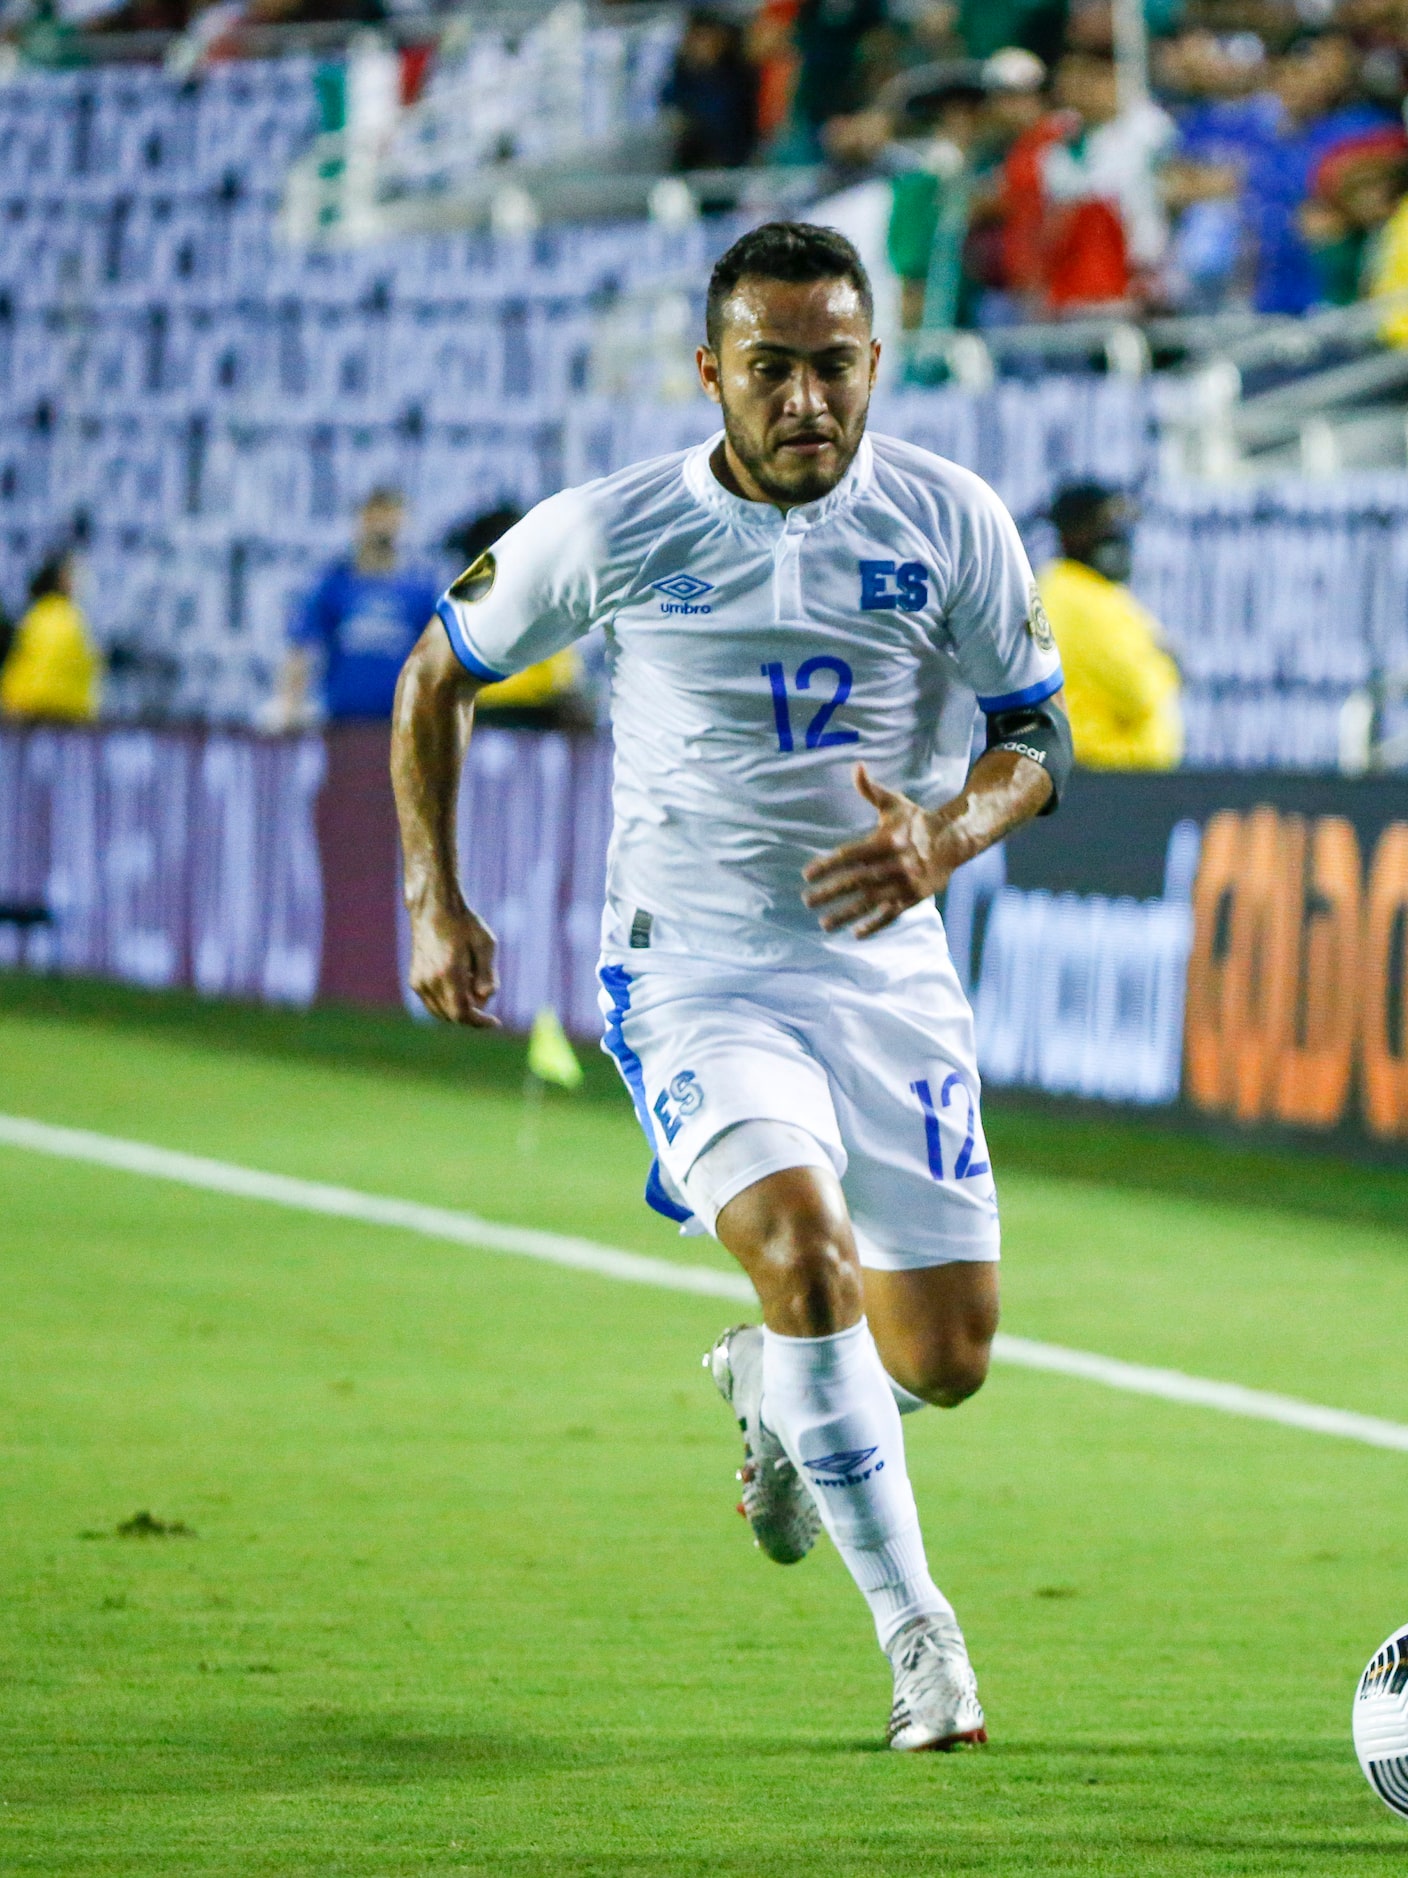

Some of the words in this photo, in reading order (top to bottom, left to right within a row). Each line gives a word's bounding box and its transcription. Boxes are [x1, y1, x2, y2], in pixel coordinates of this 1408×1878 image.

[660, 601, 712, 615] umbro
[858, 559, 929, 612] ES
[760, 655, 860, 753] 12
[1002, 740, 1048, 764] acaf
[653, 1069, 705, 1146] ES
[909, 1071, 989, 1182] 12
[812, 1460, 886, 1487] umbro
